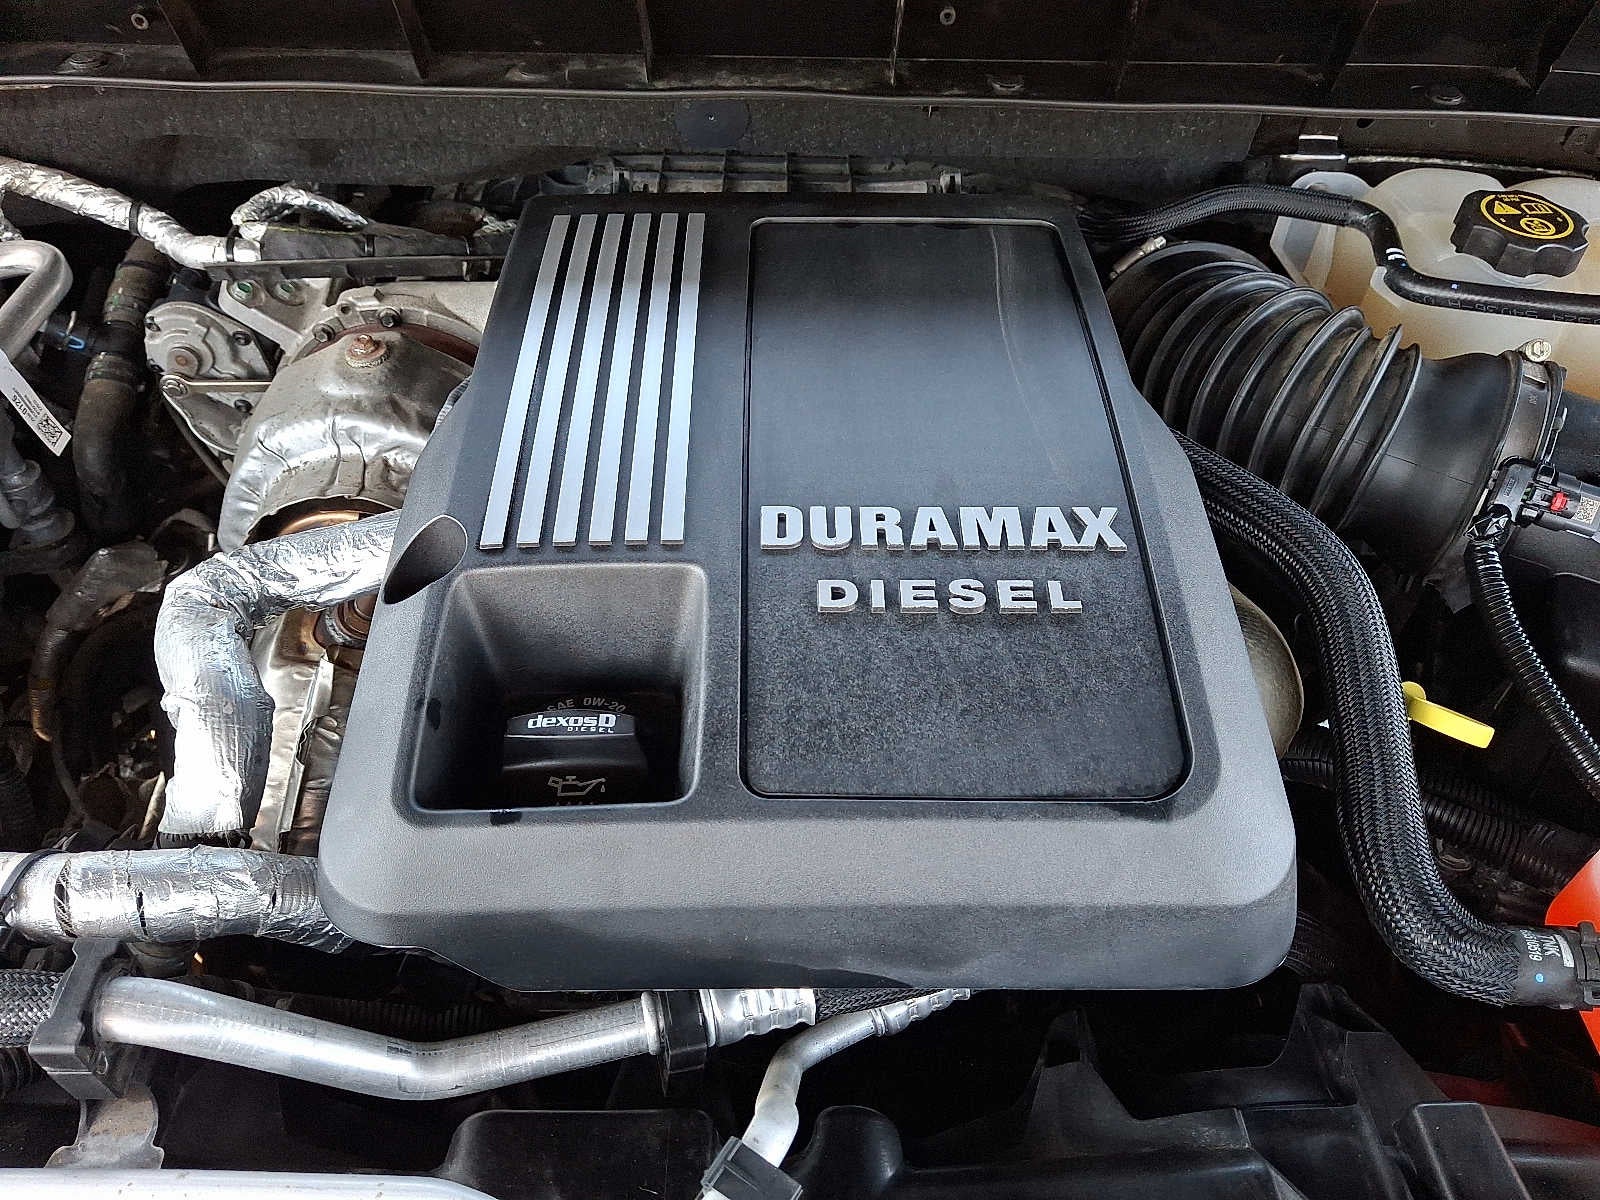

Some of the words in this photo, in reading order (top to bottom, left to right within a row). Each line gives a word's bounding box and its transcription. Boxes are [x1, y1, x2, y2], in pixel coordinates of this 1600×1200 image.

[760, 505, 1128, 552] DURAMAX
[817, 578, 1083, 614] DIESEL
[567, 726, 615, 734] DIESEL
